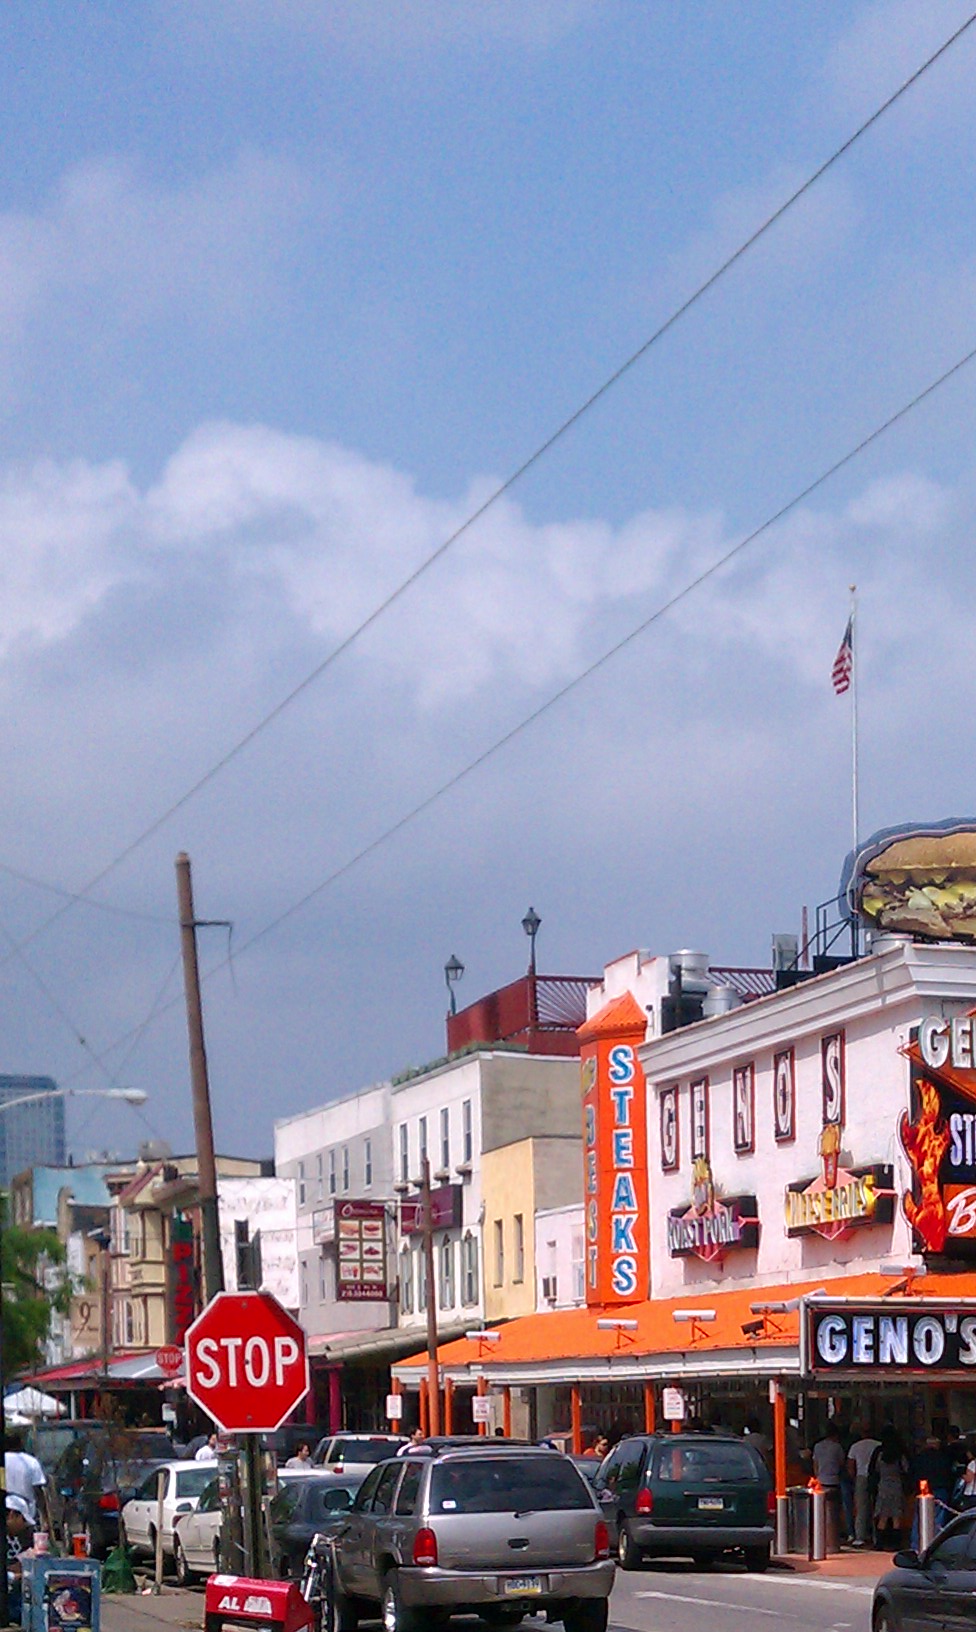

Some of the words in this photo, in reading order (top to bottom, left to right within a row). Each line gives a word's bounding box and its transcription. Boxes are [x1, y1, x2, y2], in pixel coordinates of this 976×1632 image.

[608, 1044, 639, 1296] STEAKS
[157, 1352, 180, 1363] STOP
[196, 1336, 299, 1389] STOP
[218, 1595, 240, 1610] AL
